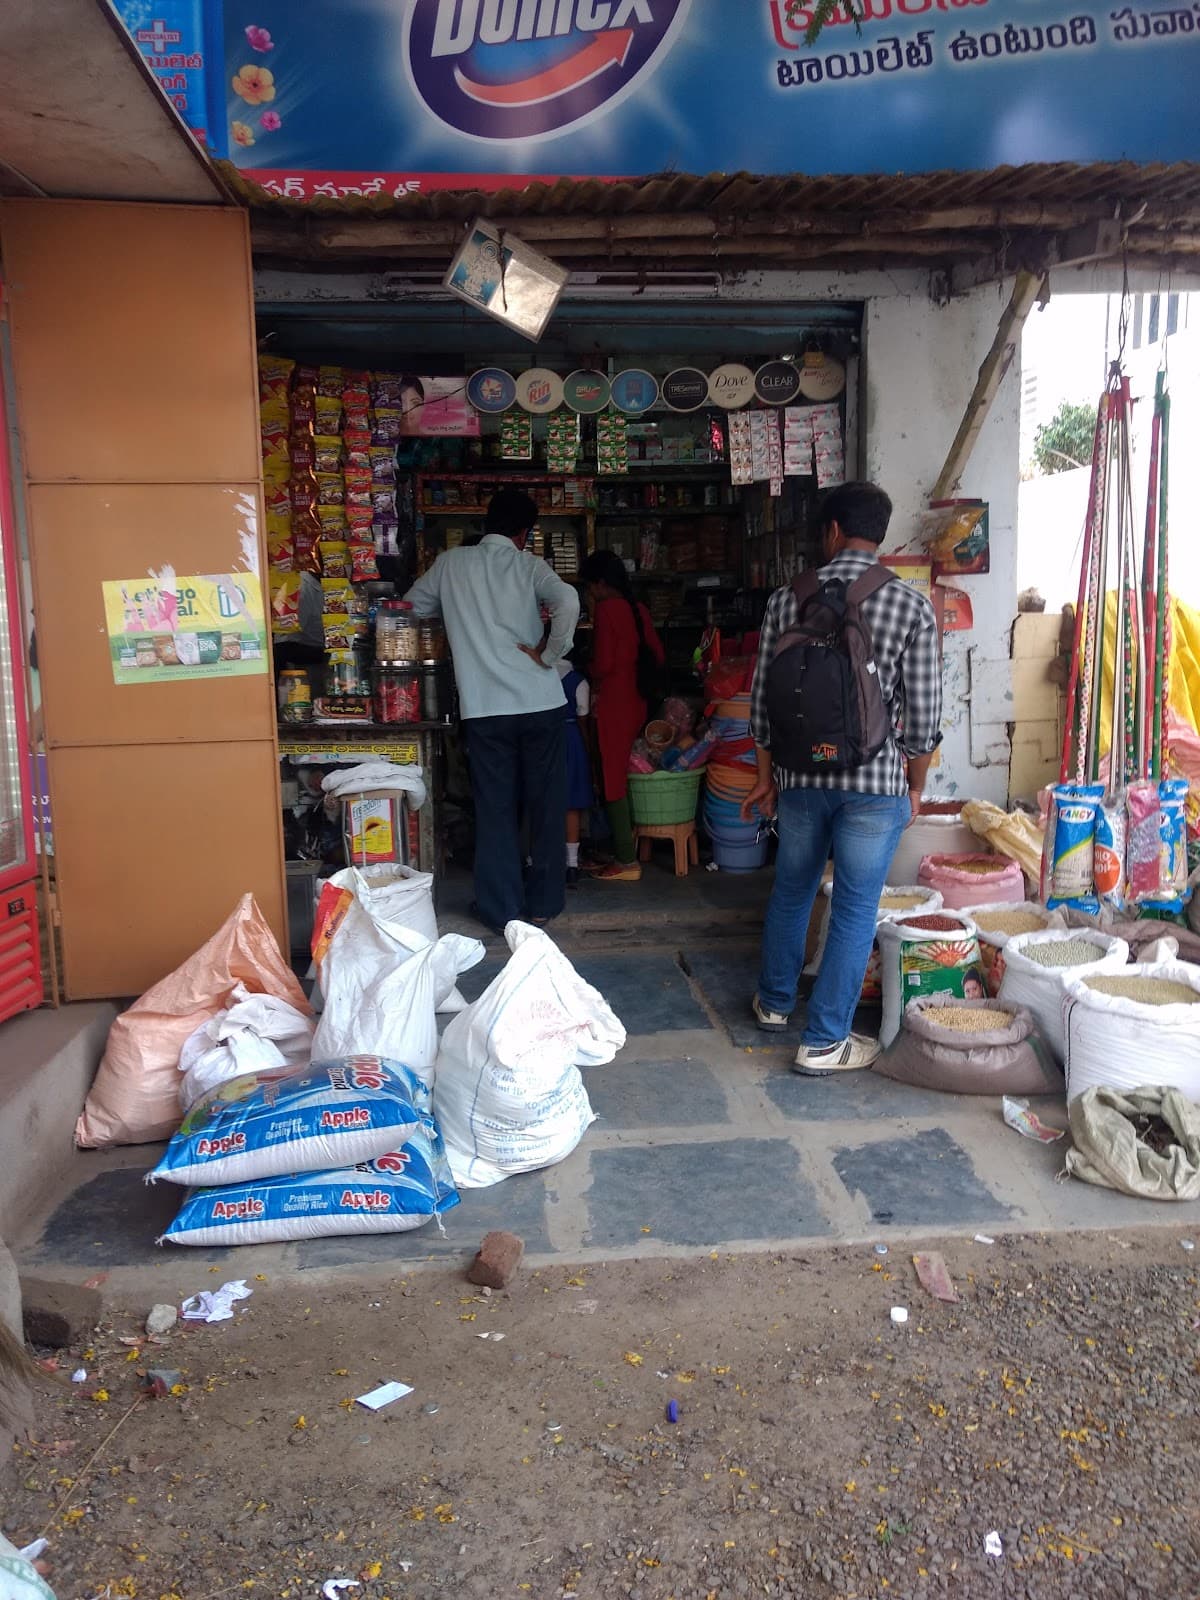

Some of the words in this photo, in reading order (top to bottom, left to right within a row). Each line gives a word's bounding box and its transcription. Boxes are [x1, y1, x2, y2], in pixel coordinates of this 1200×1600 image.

[777, 30, 935, 87] టాయిలెట్
[948, 16, 1097, 60] ఉంటుంది
[715, 375, 749, 388] Dove
[761, 375, 794, 388] CLEAR
[1060, 808, 1094, 820] FANCY
[319, 1107, 371, 1129] Apple
[197, 1131, 246, 1156] Apple
[212, 1197, 265, 1220] Apple
[339, 1190, 391, 1210] Apple
